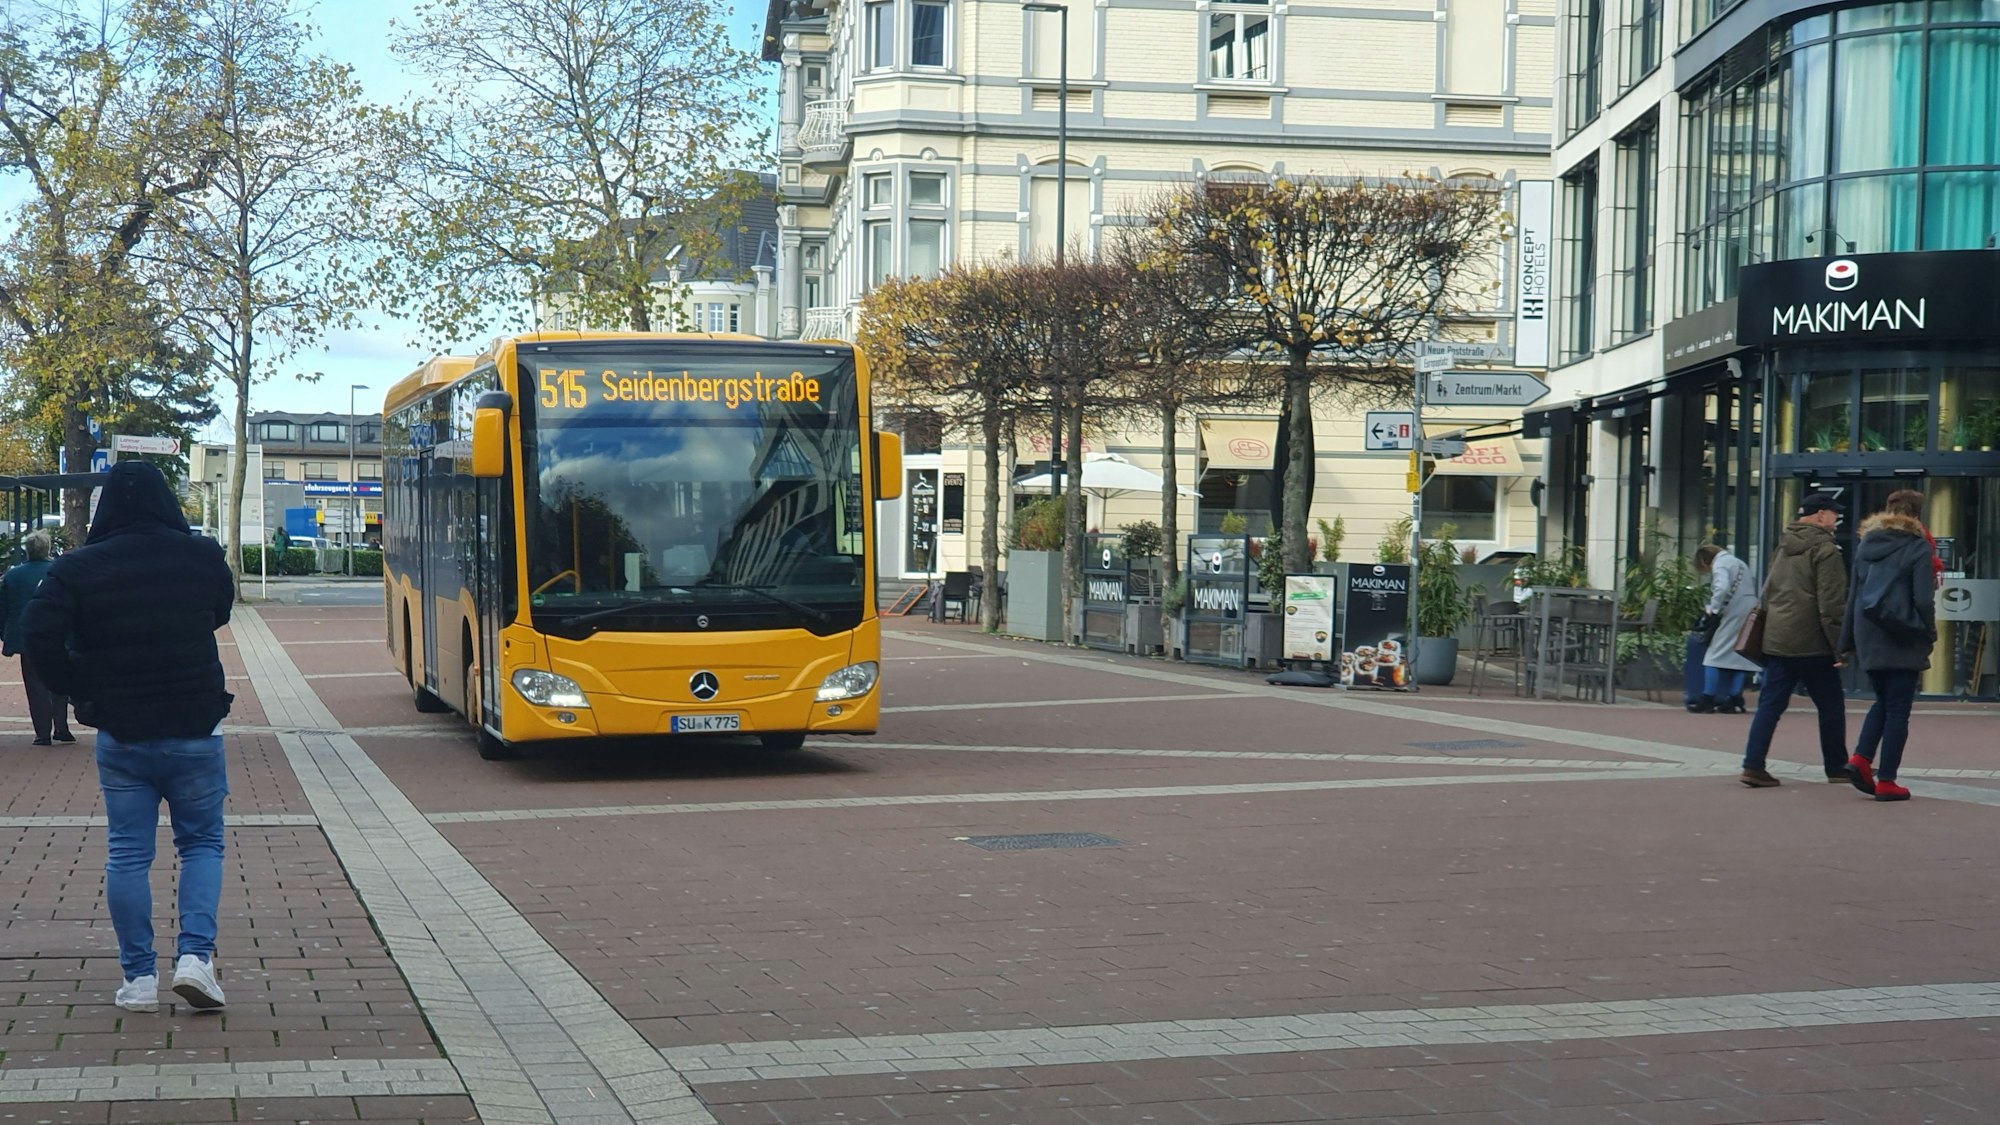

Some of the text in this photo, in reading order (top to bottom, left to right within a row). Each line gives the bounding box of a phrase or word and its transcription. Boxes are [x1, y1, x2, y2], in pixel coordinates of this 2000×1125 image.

[1522, 227, 1535, 295] KONCEPT
[1533, 243, 1546, 296] HOTELS
[1772, 297, 1925, 336] MAKIMAN
[1427, 345, 1446, 355] Neue
[539, 369, 820, 410] 515 Seidenbergstraße
[1455, 383, 1522, 396] Zentrum/Markt
[1088, 581, 1123, 602] MAKIMAN
[1351, 577, 1405, 591] MAKIMAN
[1194, 588, 1239, 611] MAKIMAN
[678, 717, 696, 730] SU
[715, 715, 739, 730] 775
